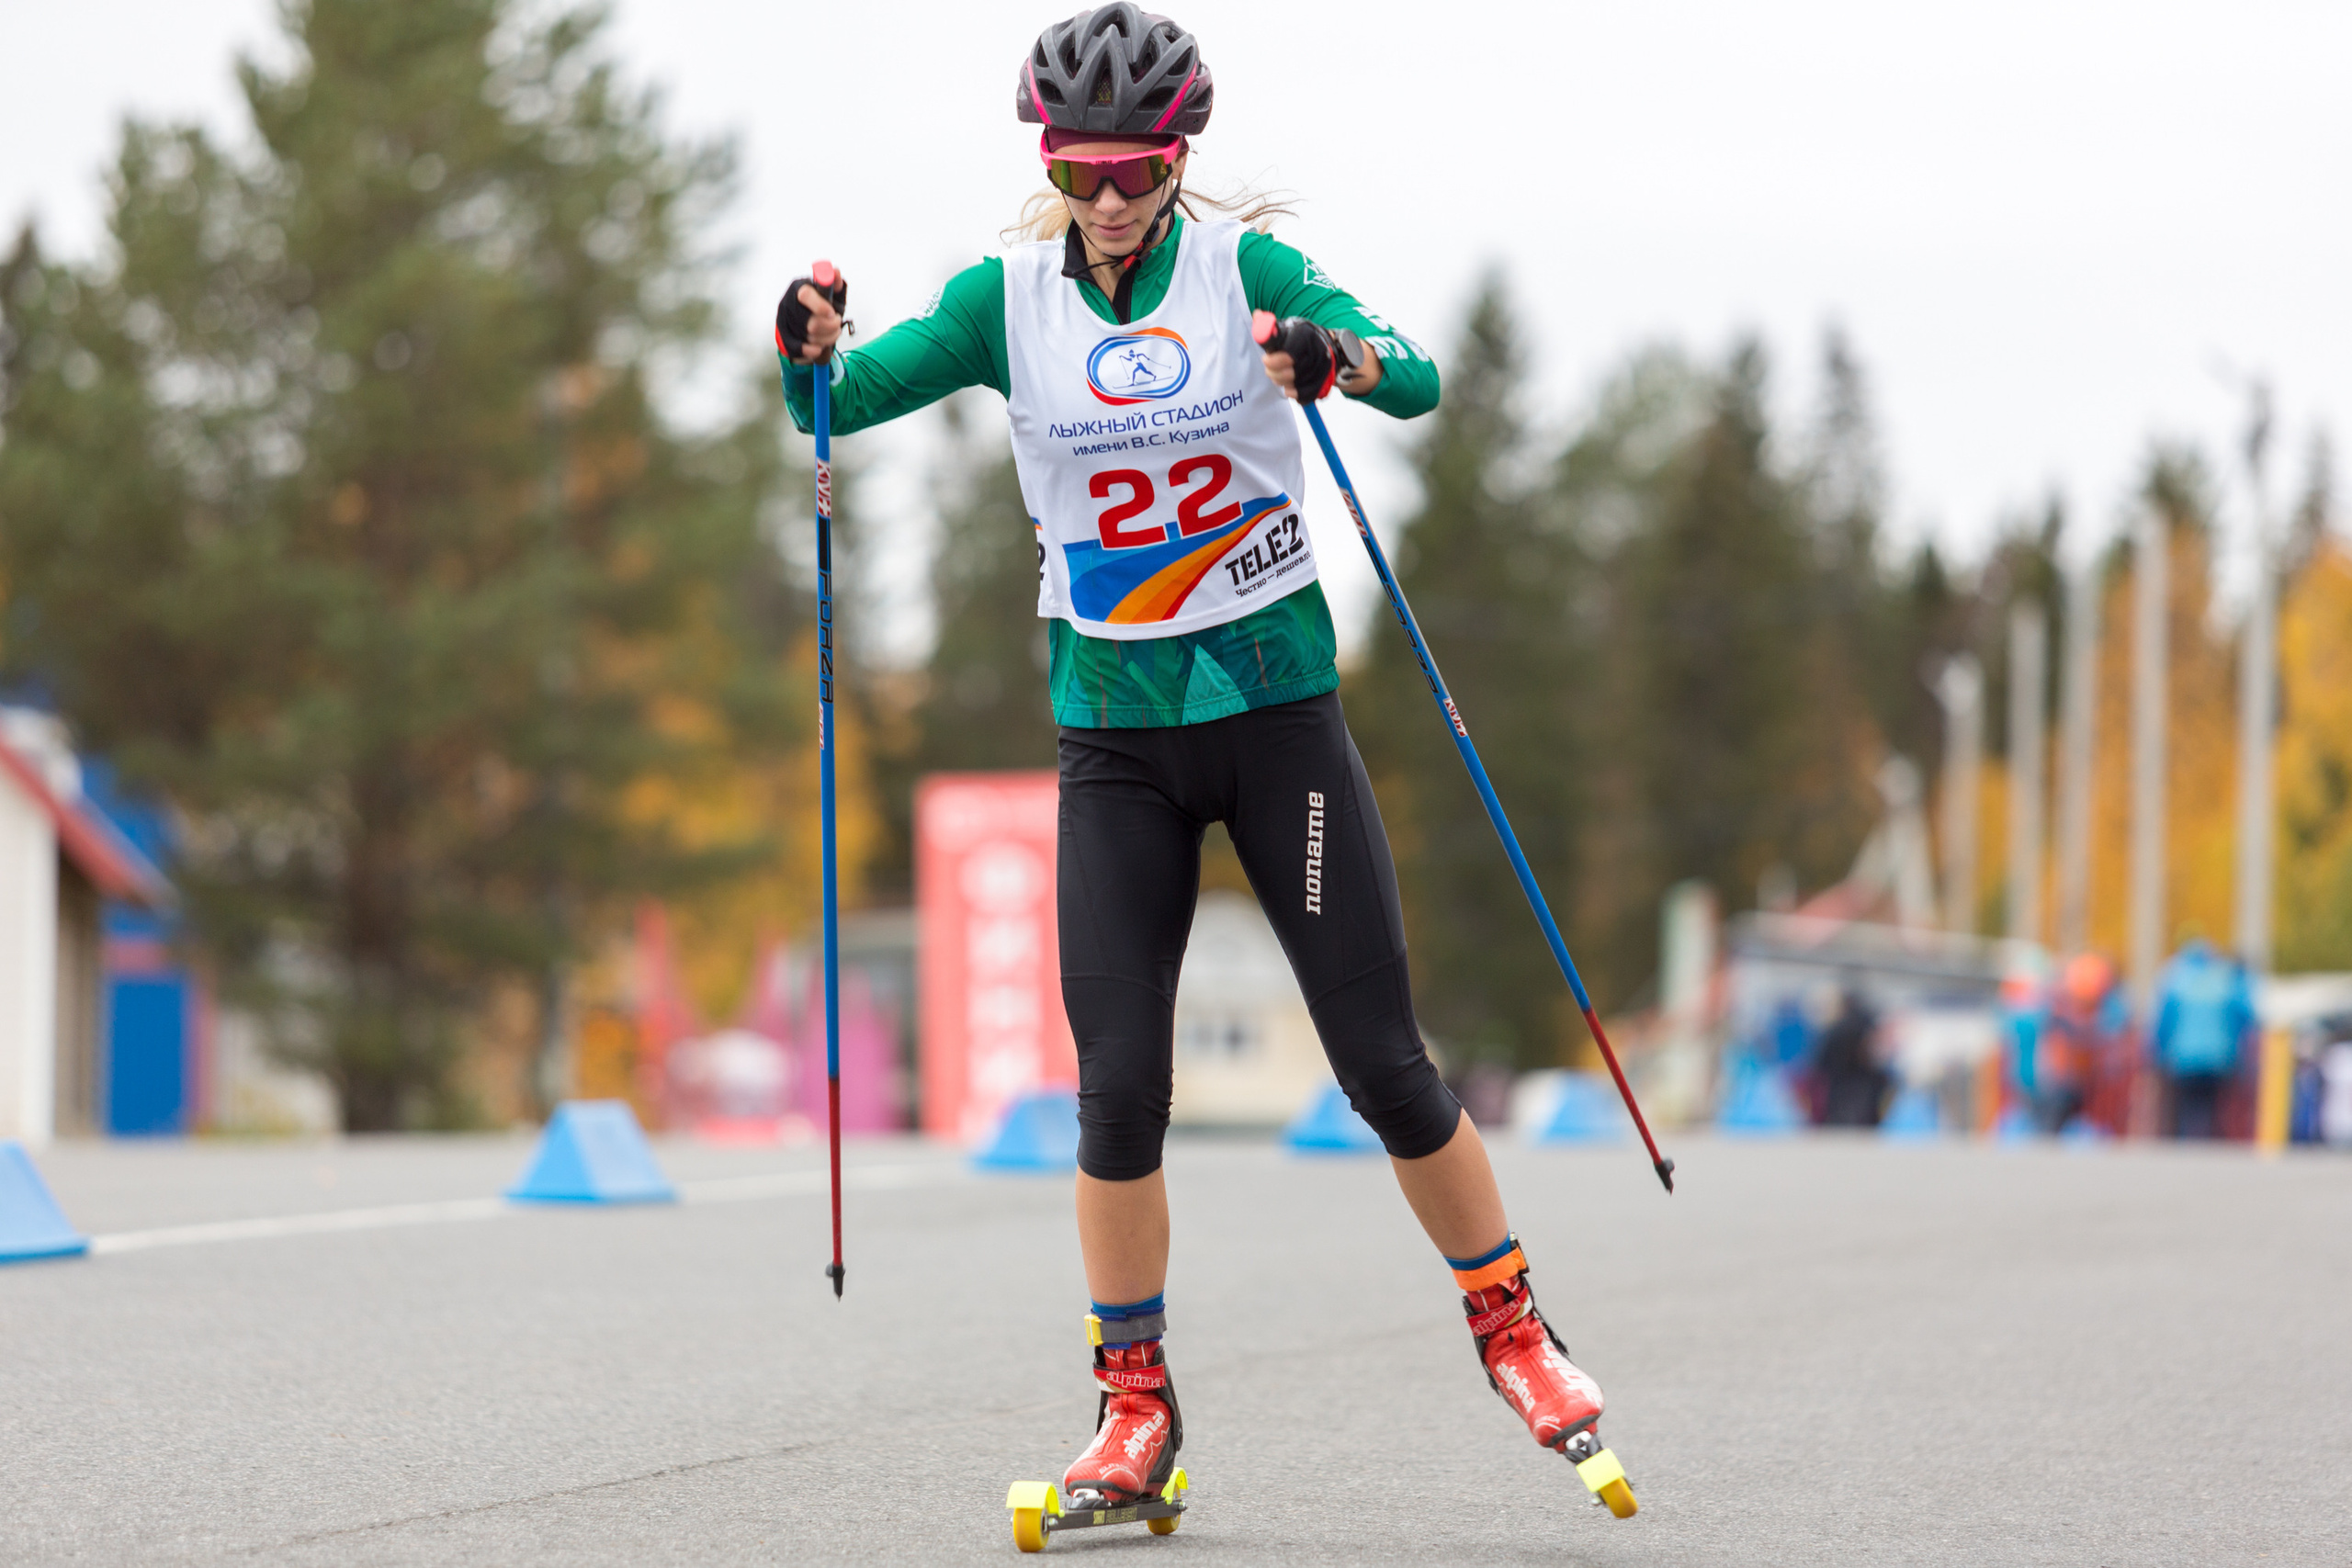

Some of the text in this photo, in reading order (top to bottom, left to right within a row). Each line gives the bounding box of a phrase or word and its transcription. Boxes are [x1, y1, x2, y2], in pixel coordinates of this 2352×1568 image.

[1049, 389, 1243, 438] ЛЫЖНЫЙ СТАДИОН
[1073, 422, 1229, 457] имени В.С. Кузина
[1089, 454, 1242, 549] 22
[1225, 513, 1305, 586] TELE2
[1235, 578, 1267, 597] Честно
[819, 570, 834, 705] FORZA
[1306, 791, 1325, 916] noname
[1472, 1298, 1521, 1337] alpina
[1106, 1371, 1167, 1388] alpina
[1496, 1362, 1536, 1414] alpina
[1123, 1410, 1166, 1461] alpina
